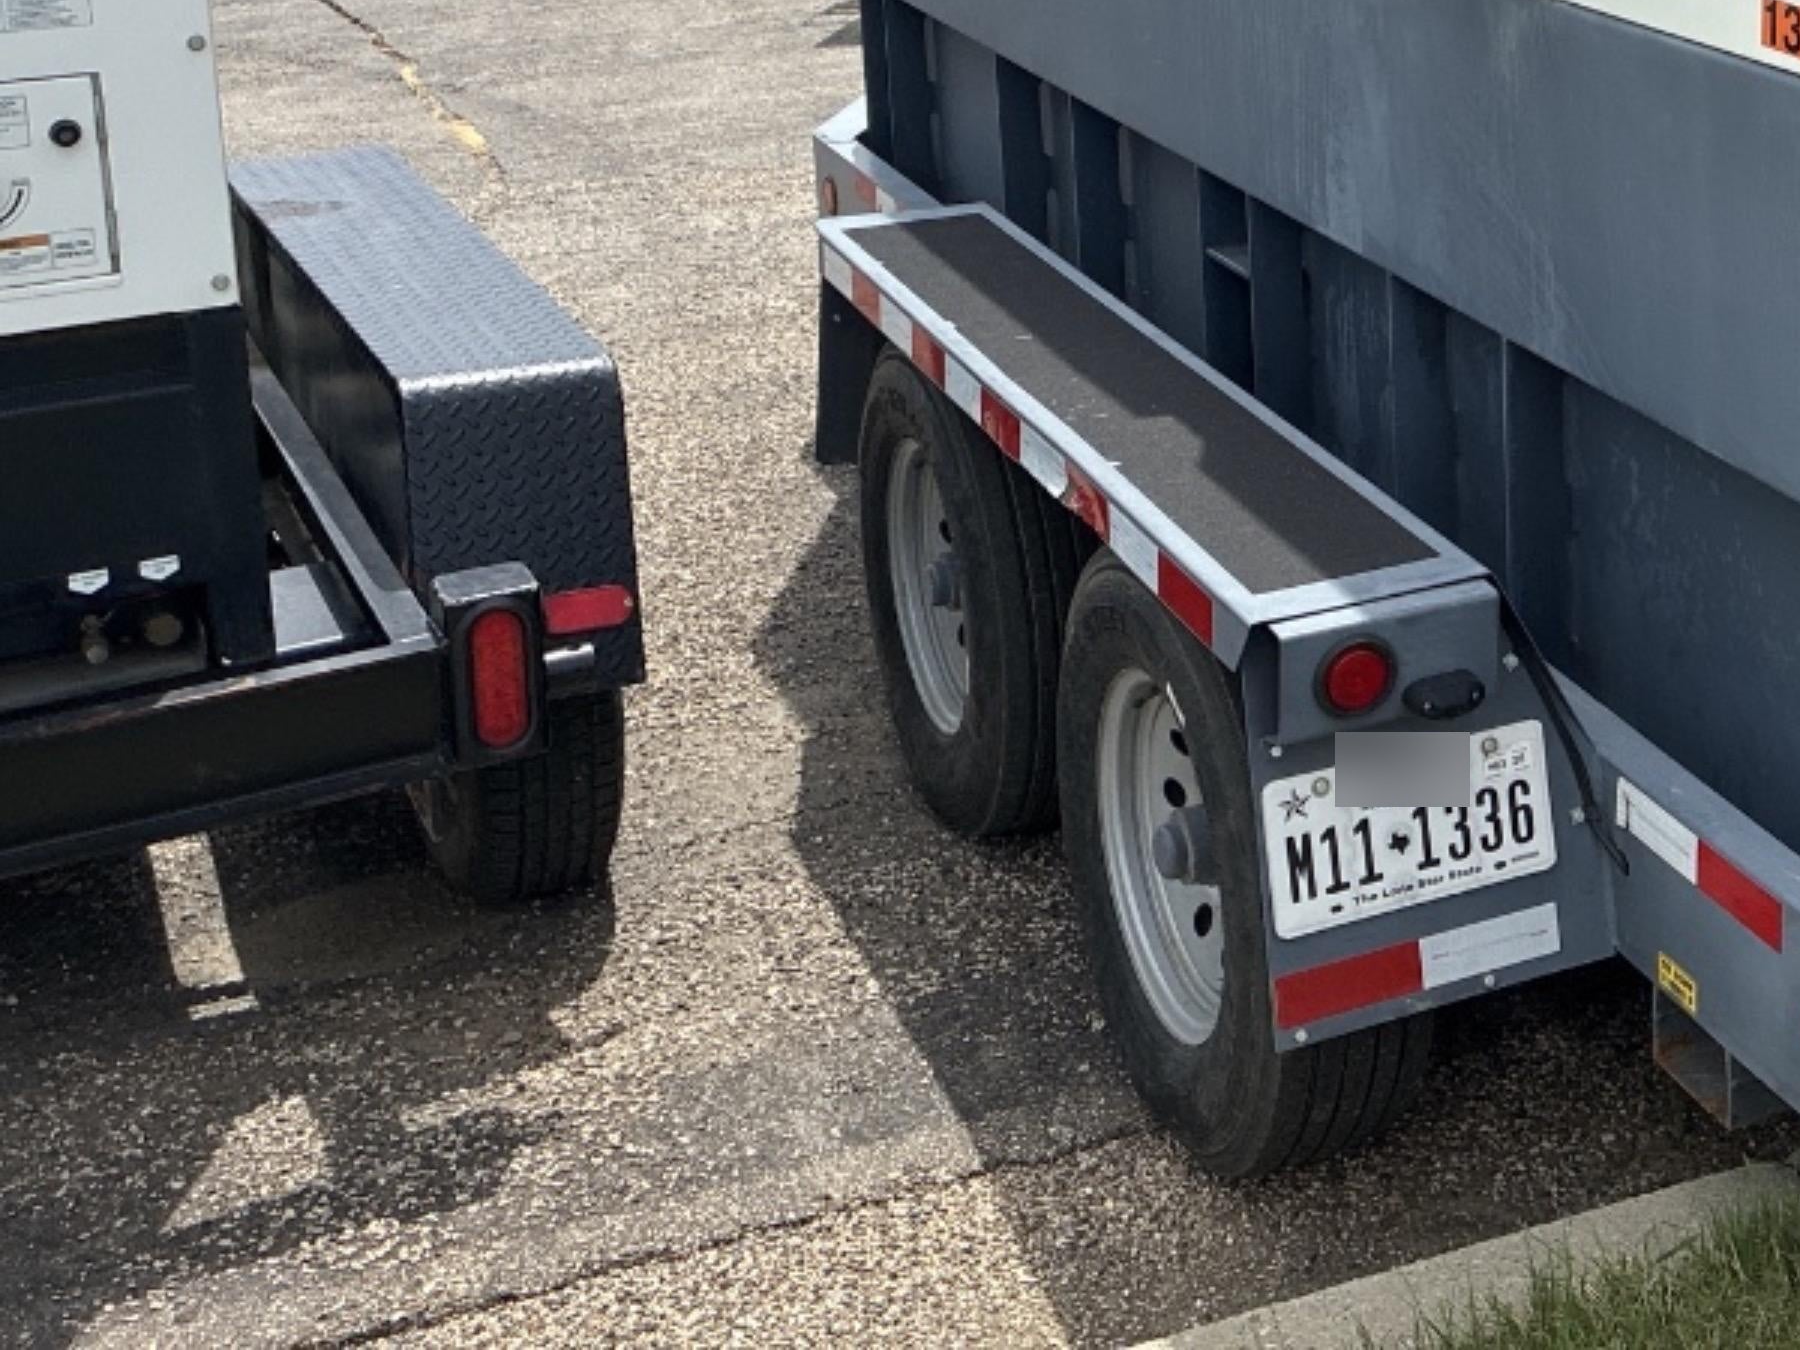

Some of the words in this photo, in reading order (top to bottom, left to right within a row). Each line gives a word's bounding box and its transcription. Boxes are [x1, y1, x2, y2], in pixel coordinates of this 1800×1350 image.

[1286, 817, 1385, 904] M11
[1412, 778, 1535, 872] 1336
[1352, 893, 1378, 907] The
